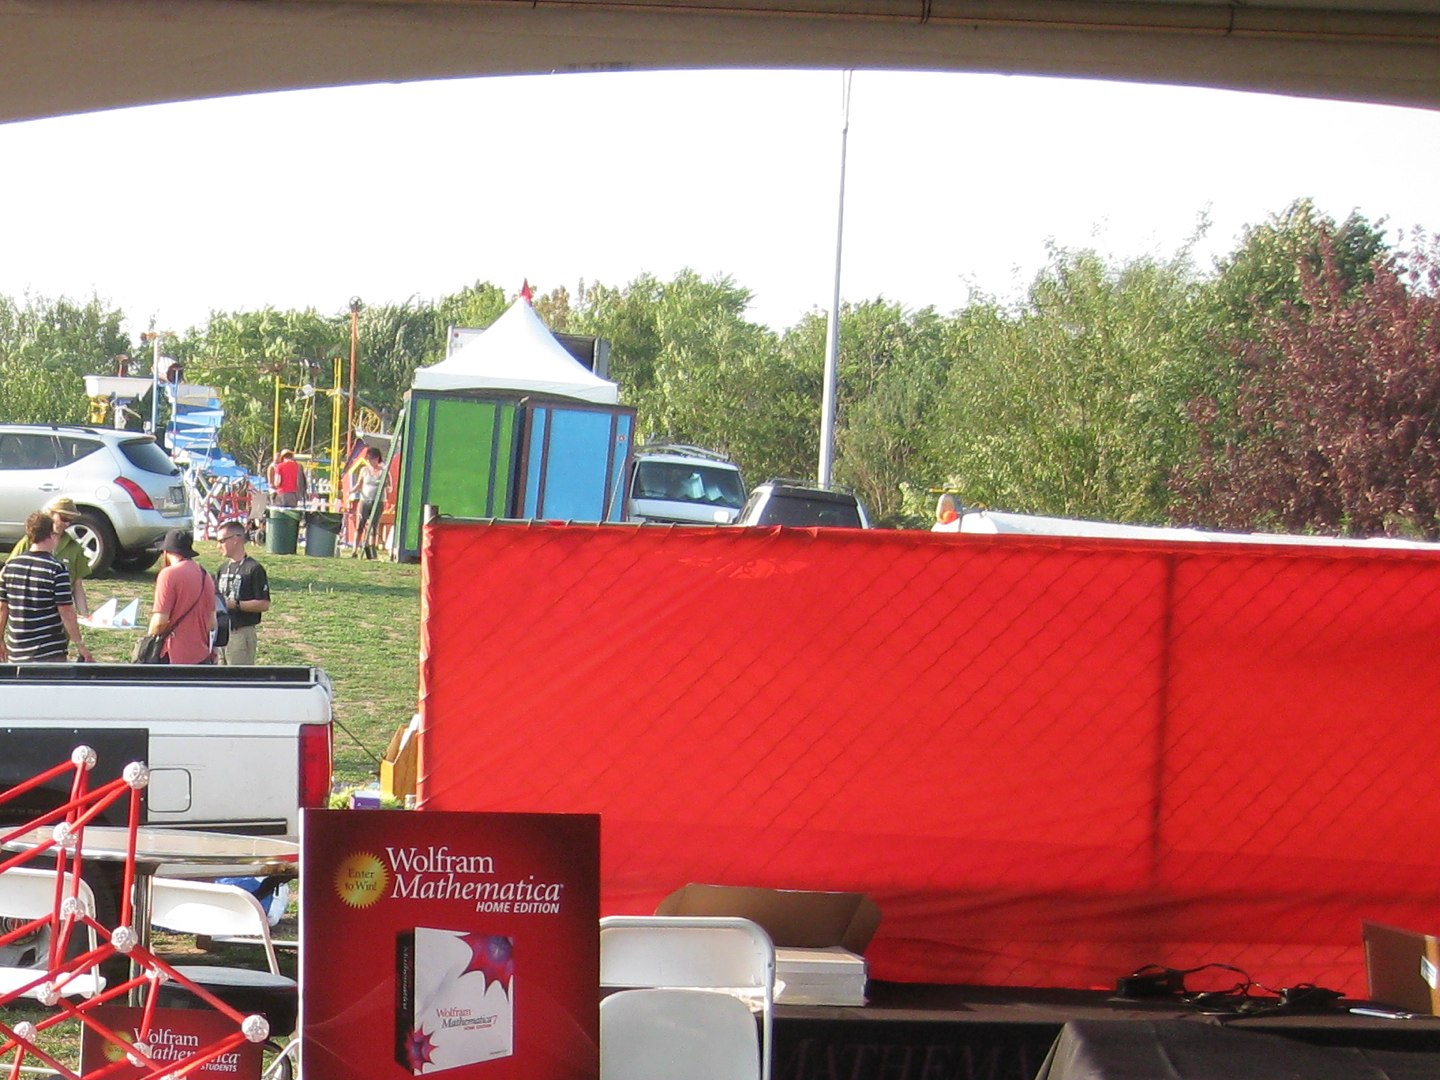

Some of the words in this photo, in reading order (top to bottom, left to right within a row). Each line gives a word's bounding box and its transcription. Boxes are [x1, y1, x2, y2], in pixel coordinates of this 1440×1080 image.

[386, 846, 495, 874] Wolfram
[348, 868, 374, 880] Enter
[345, 882, 354, 891] to
[356, 881, 377, 891] Win!
[390, 874, 561, 901] Mathematica
[476, 901, 510, 914] HOME
[513, 902, 560, 914] EDITION
[436, 1006, 472, 1019] Wolfram
